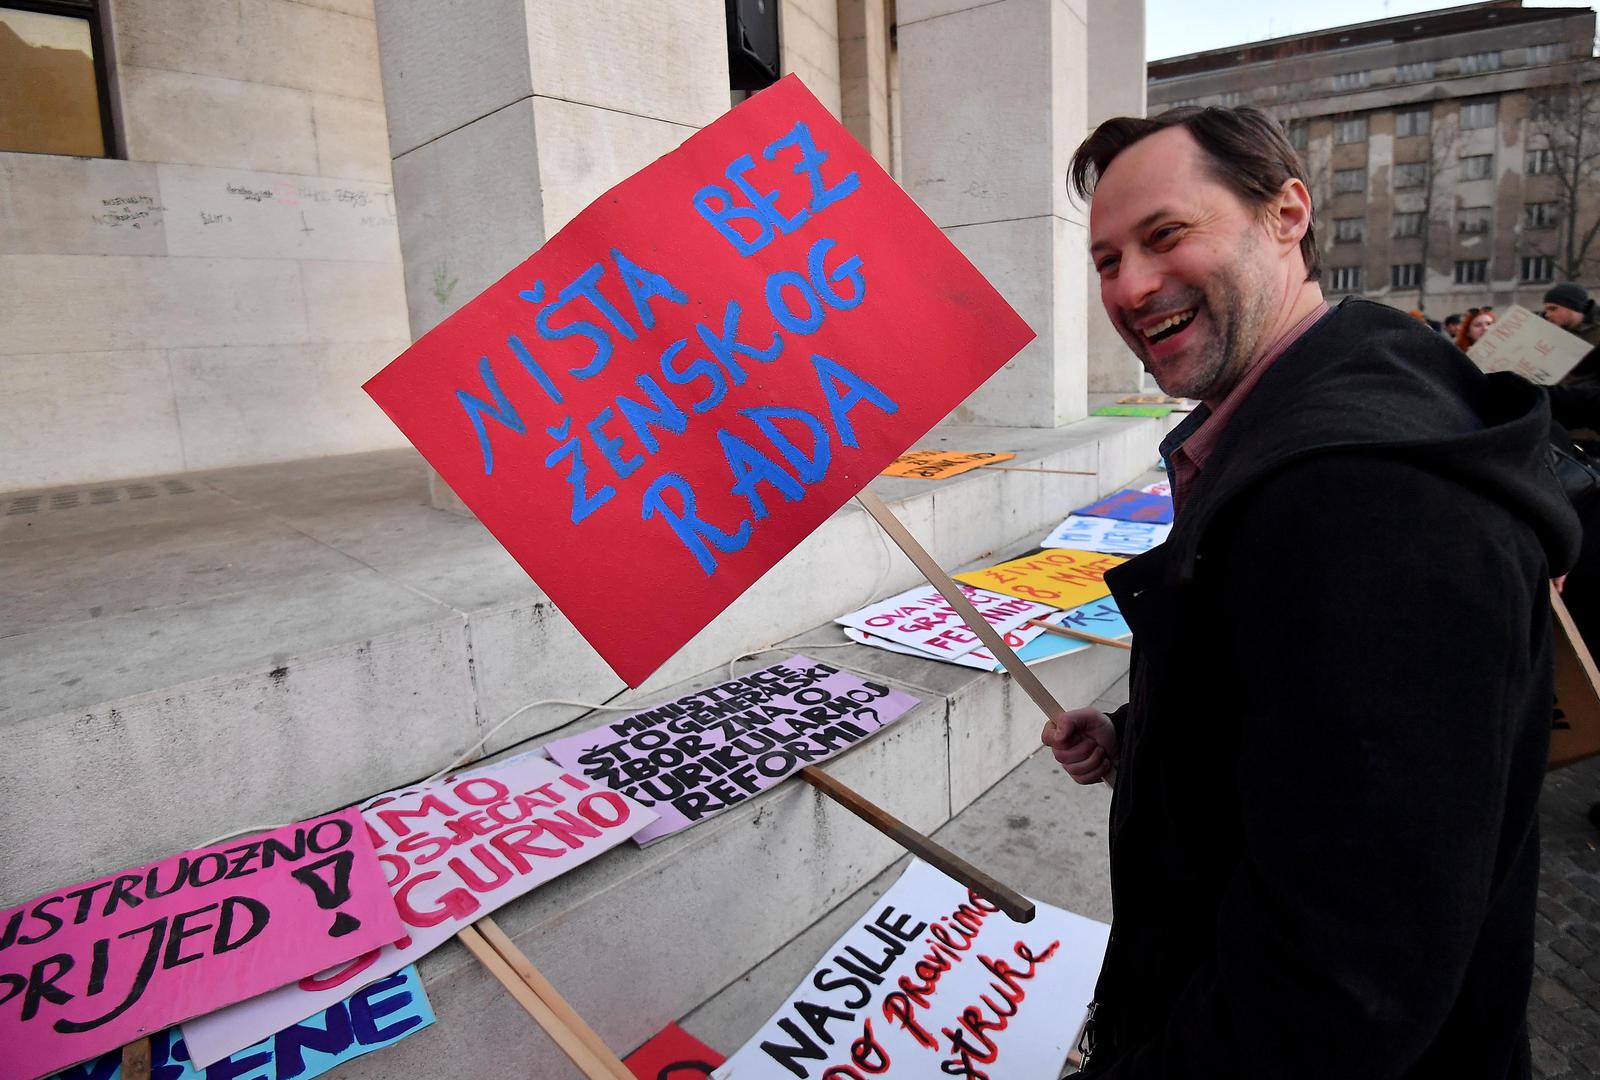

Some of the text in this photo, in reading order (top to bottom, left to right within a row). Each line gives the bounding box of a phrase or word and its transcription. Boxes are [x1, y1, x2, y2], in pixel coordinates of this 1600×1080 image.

[455, 120, 861, 476] NIŠTA BEZ
[545, 238, 866, 525] ŽENSKOG
[642, 353, 899, 576] RADA
[865, 606, 927, 628] OVA
[985, 554, 1076, 585] ŽIVIO
[577, 730, 671, 776] ŠTO
[706, 705, 798, 742] ZNA
[793, 687, 832, 705] O
[760, 906, 928, 1079] NASILJE
